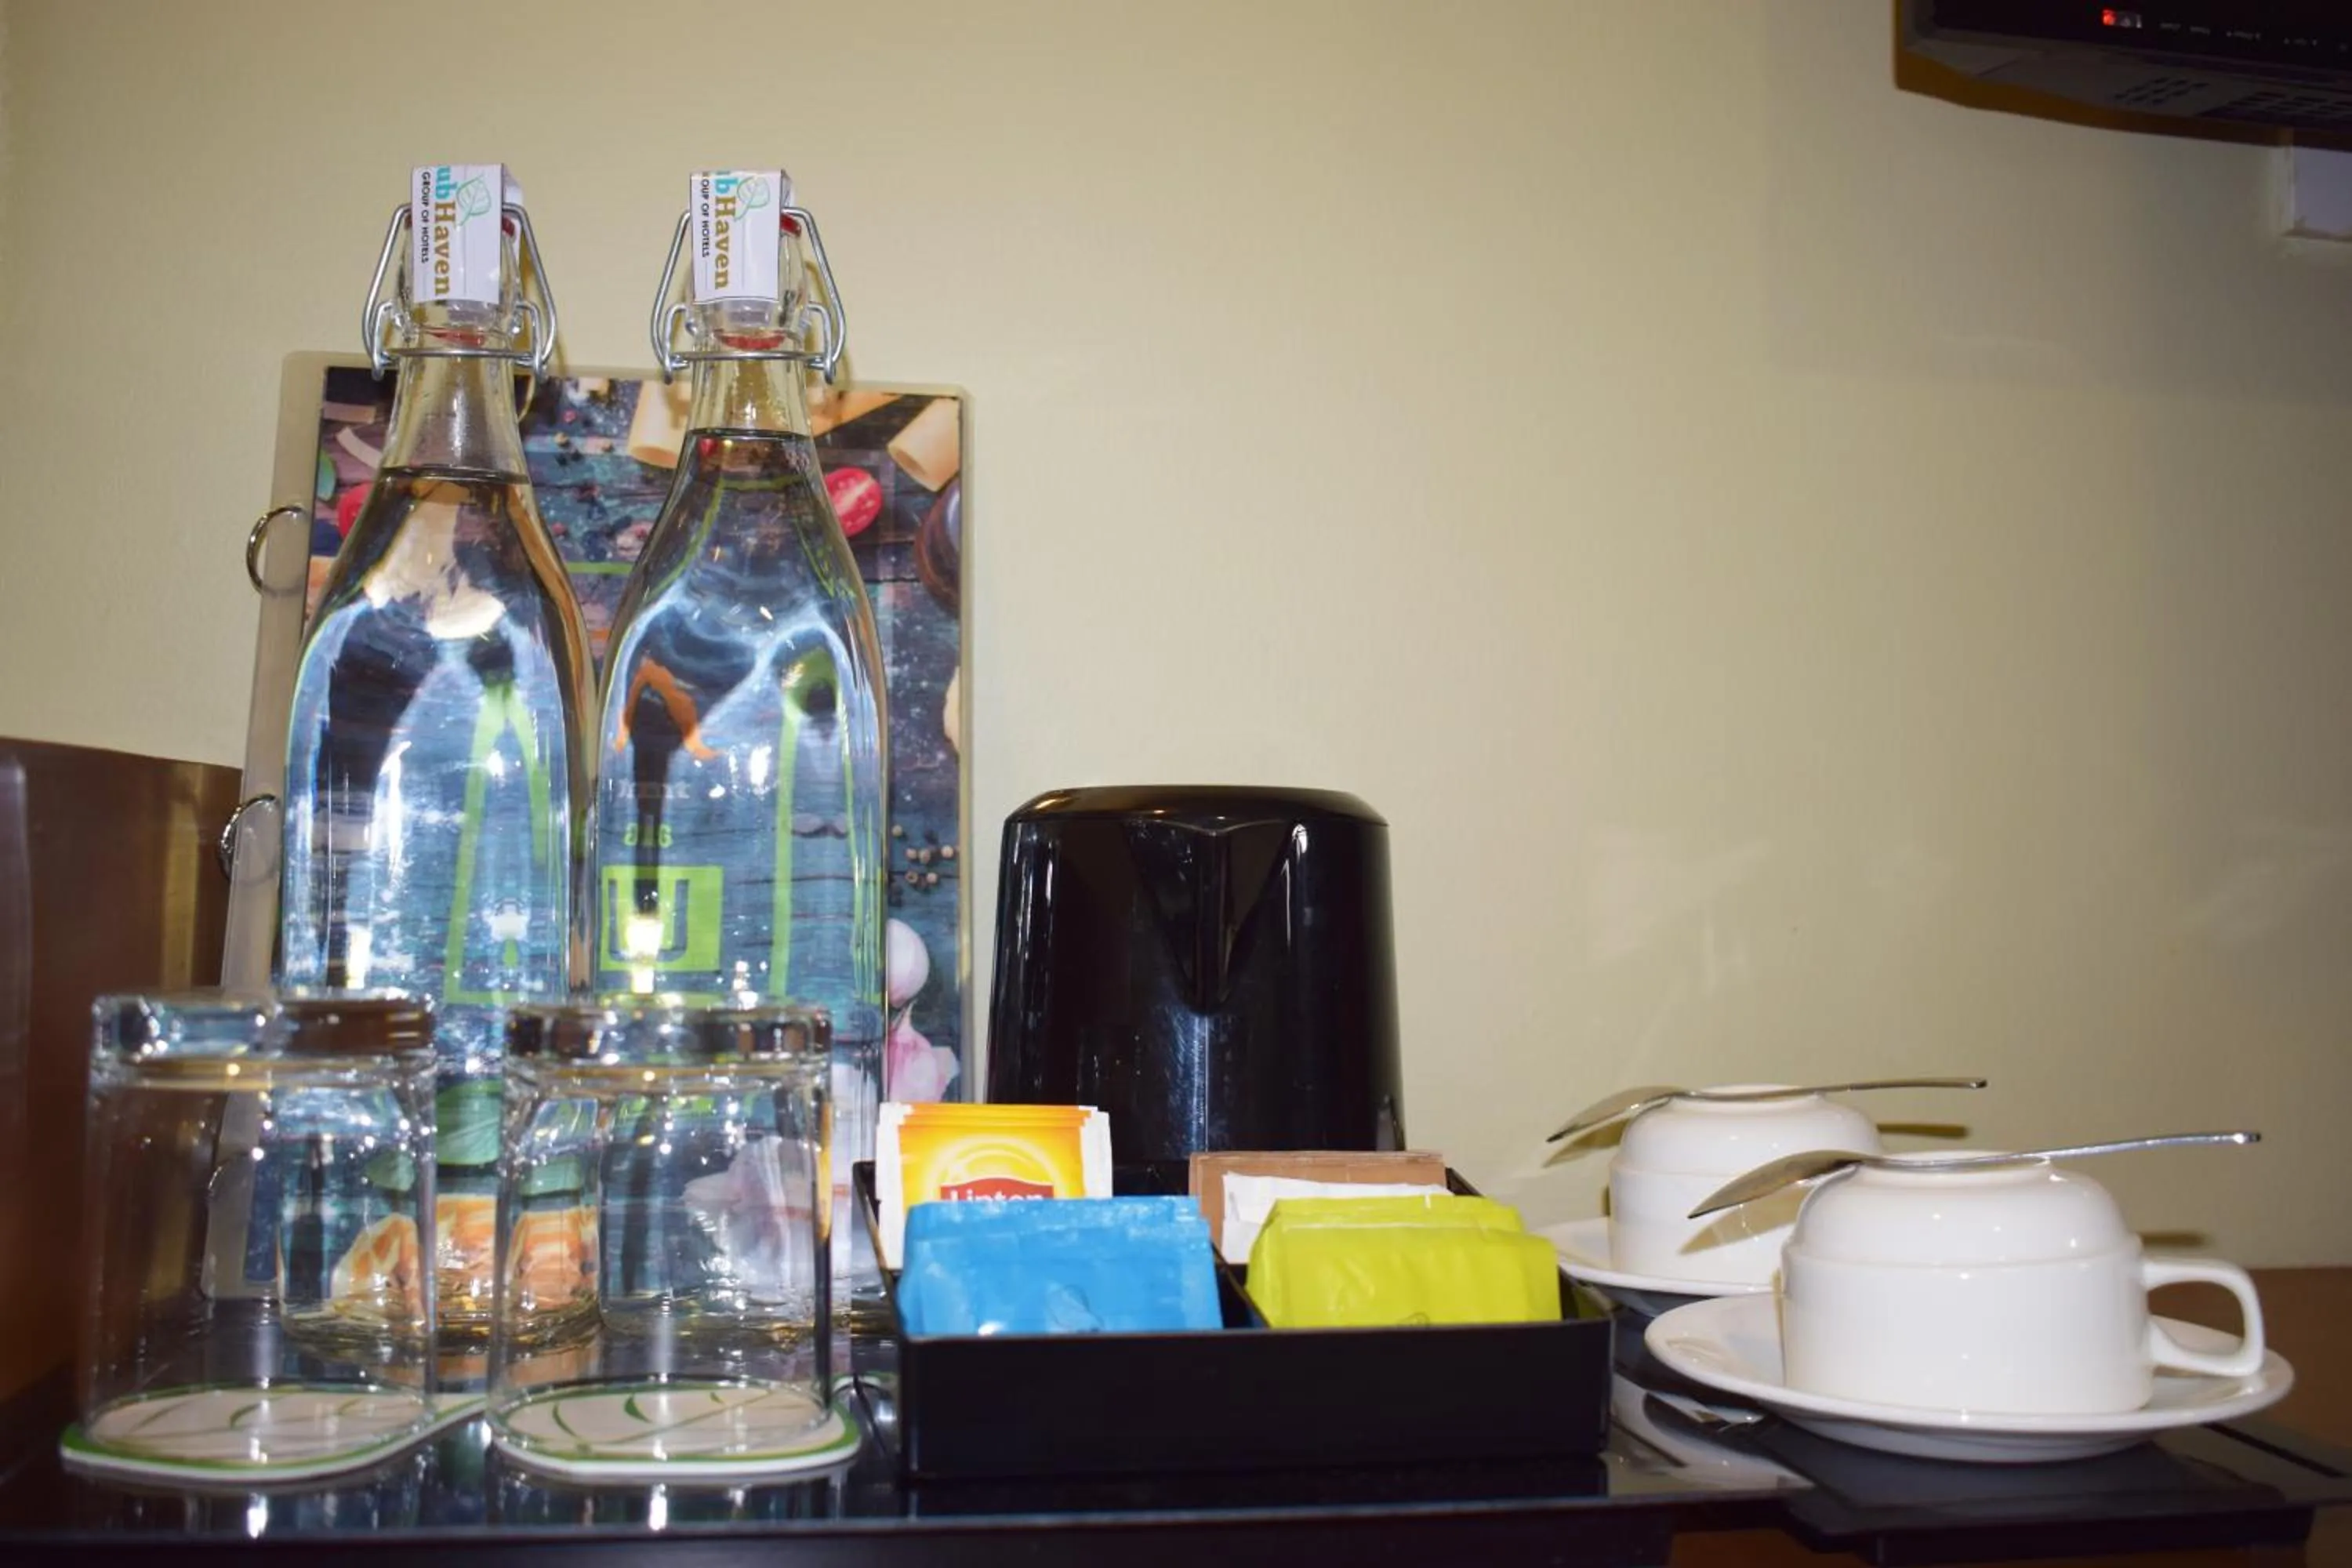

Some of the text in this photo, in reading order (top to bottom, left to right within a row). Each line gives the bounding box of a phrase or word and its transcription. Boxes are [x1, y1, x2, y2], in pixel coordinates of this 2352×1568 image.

[420, 171, 430, 264] GROUP OF HOTELS
[700, 202, 710, 220] OF
[701, 220, 710, 258] HOTELS
